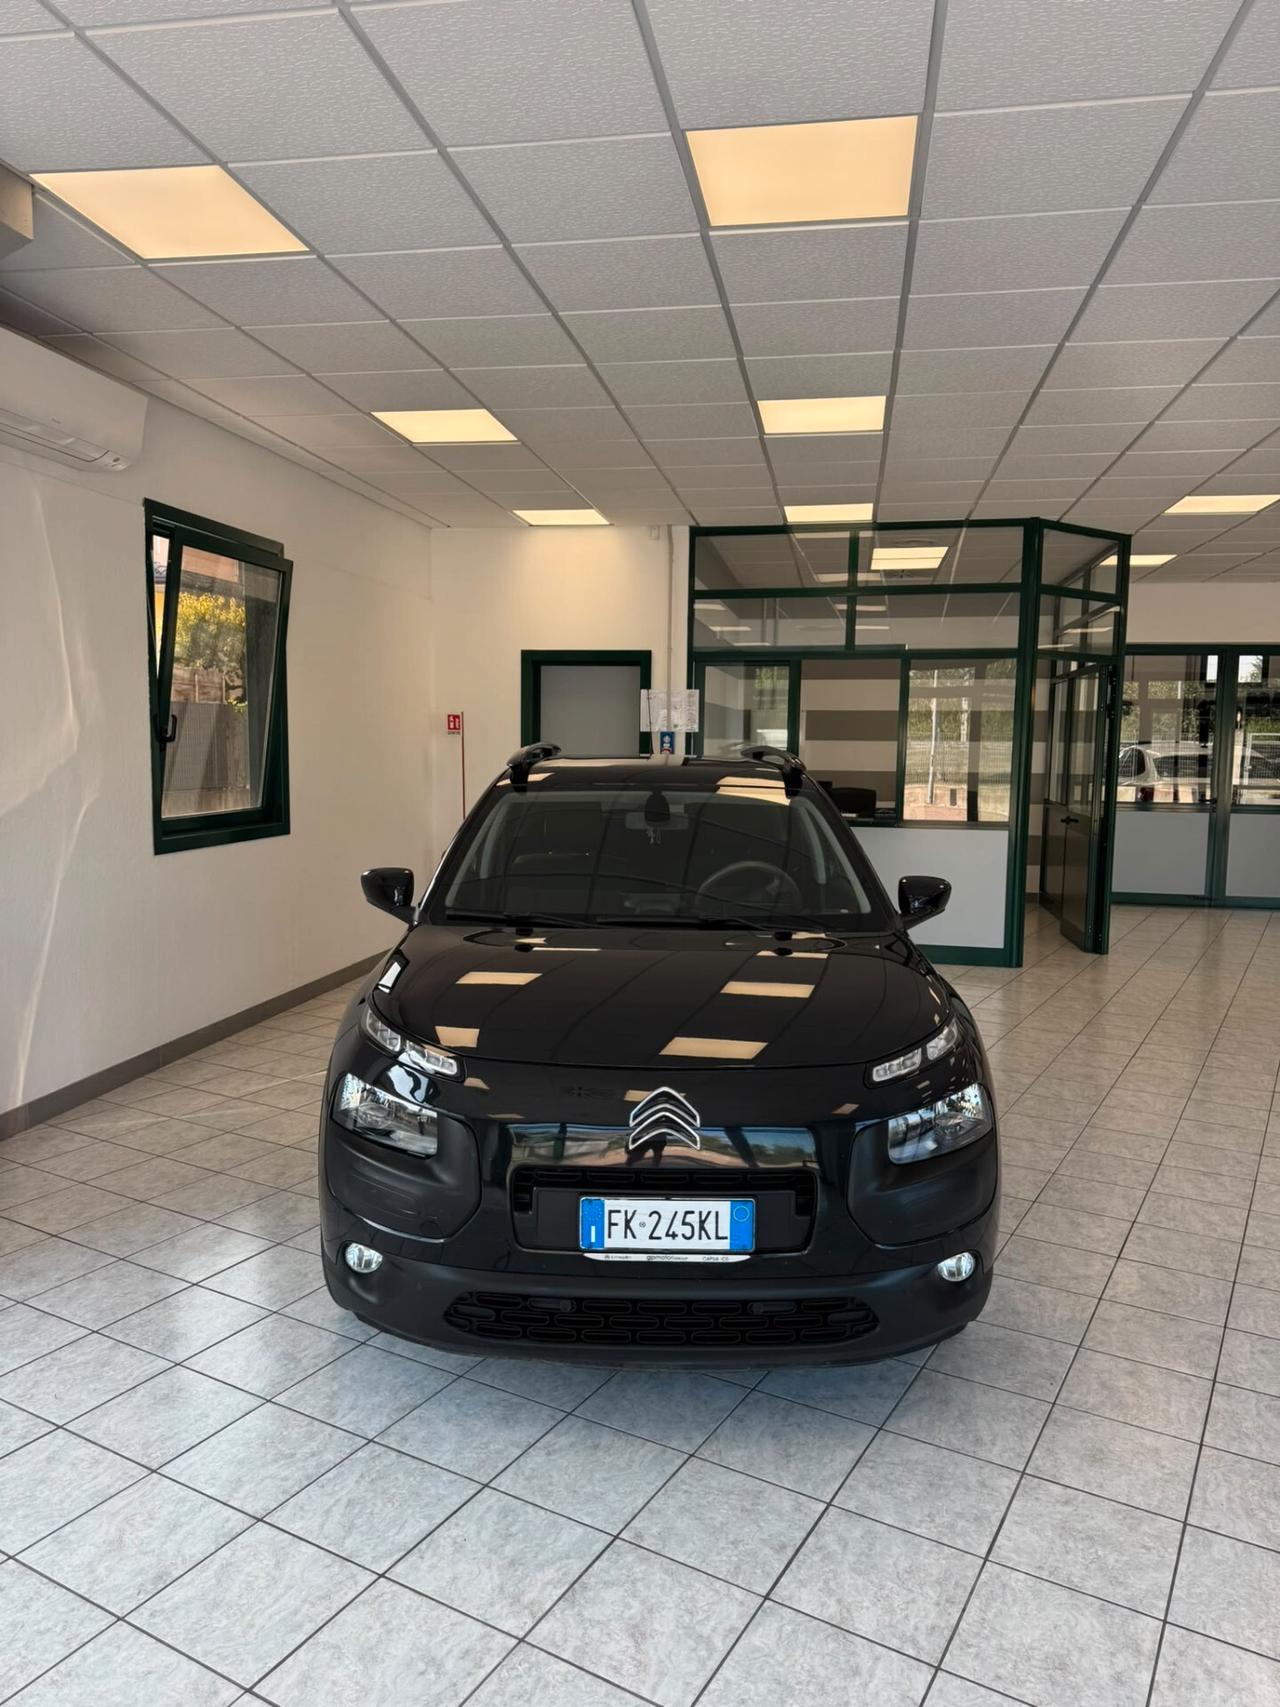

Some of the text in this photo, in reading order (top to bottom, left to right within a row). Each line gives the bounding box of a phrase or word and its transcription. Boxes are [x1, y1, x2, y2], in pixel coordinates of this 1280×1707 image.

[590, 1225, 596, 1243] I
[607, 1209, 728, 1241] FK 245KL
